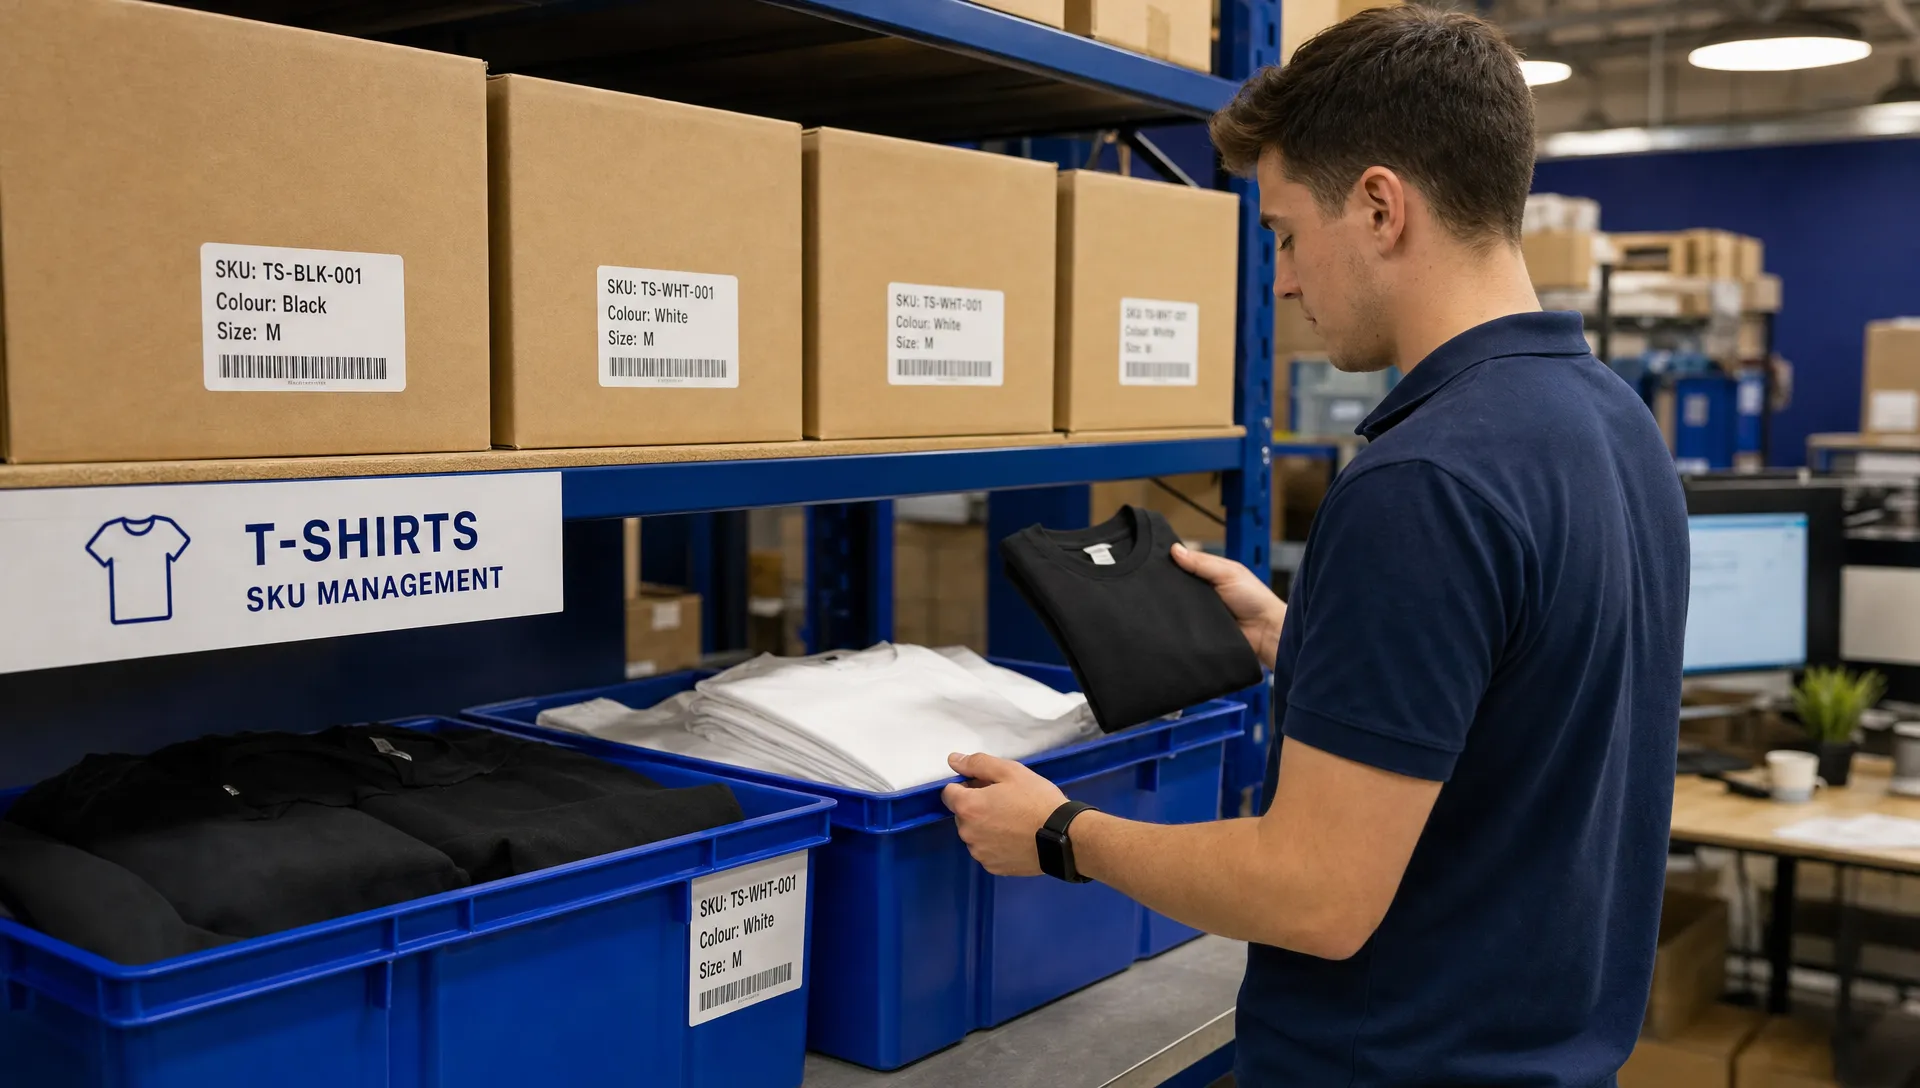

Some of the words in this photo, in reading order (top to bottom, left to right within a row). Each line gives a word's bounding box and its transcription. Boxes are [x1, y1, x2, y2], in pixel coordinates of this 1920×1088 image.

[215, 259, 256, 279] SKU:
[263, 262, 362, 285] TS-BLK-001
[607, 278, 637, 295] SKU:
[641, 281, 714, 300] TS-WHT-001
[216, 291, 276, 312] Colour:
[283, 295, 327, 314] Black
[896, 293, 920, 308] SKU:
[923, 295, 982, 312] TS-WHT-001
[608, 304, 650, 322] Colour:
[654, 308, 688, 324] White
[896, 315, 930, 330] Colour:
[933, 317, 961, 331] White
[217, 321, 257, 341] Size:
[266, 323, 281, 341] M
[608, 329, 637, 346] Size:
[643, 331, 654, 346] M
[896, 335, 919, 350] Size:
[924, 336, 934, 350] M
[245, 510, 478, 566] T-SHIRTS
[246, 583, 306, 613] SKU
[317, 565, 503, 606] MANAGEMENT
[700, 894, 727, 918] SKU:
[730, 874, 797, 909] TS-WHT-001
[700, 925, 739, 949] Colour:
[744, 912, 774, 936] White
[699, 959, 726, 980] Size:
[732, 949, 742, 969] M
